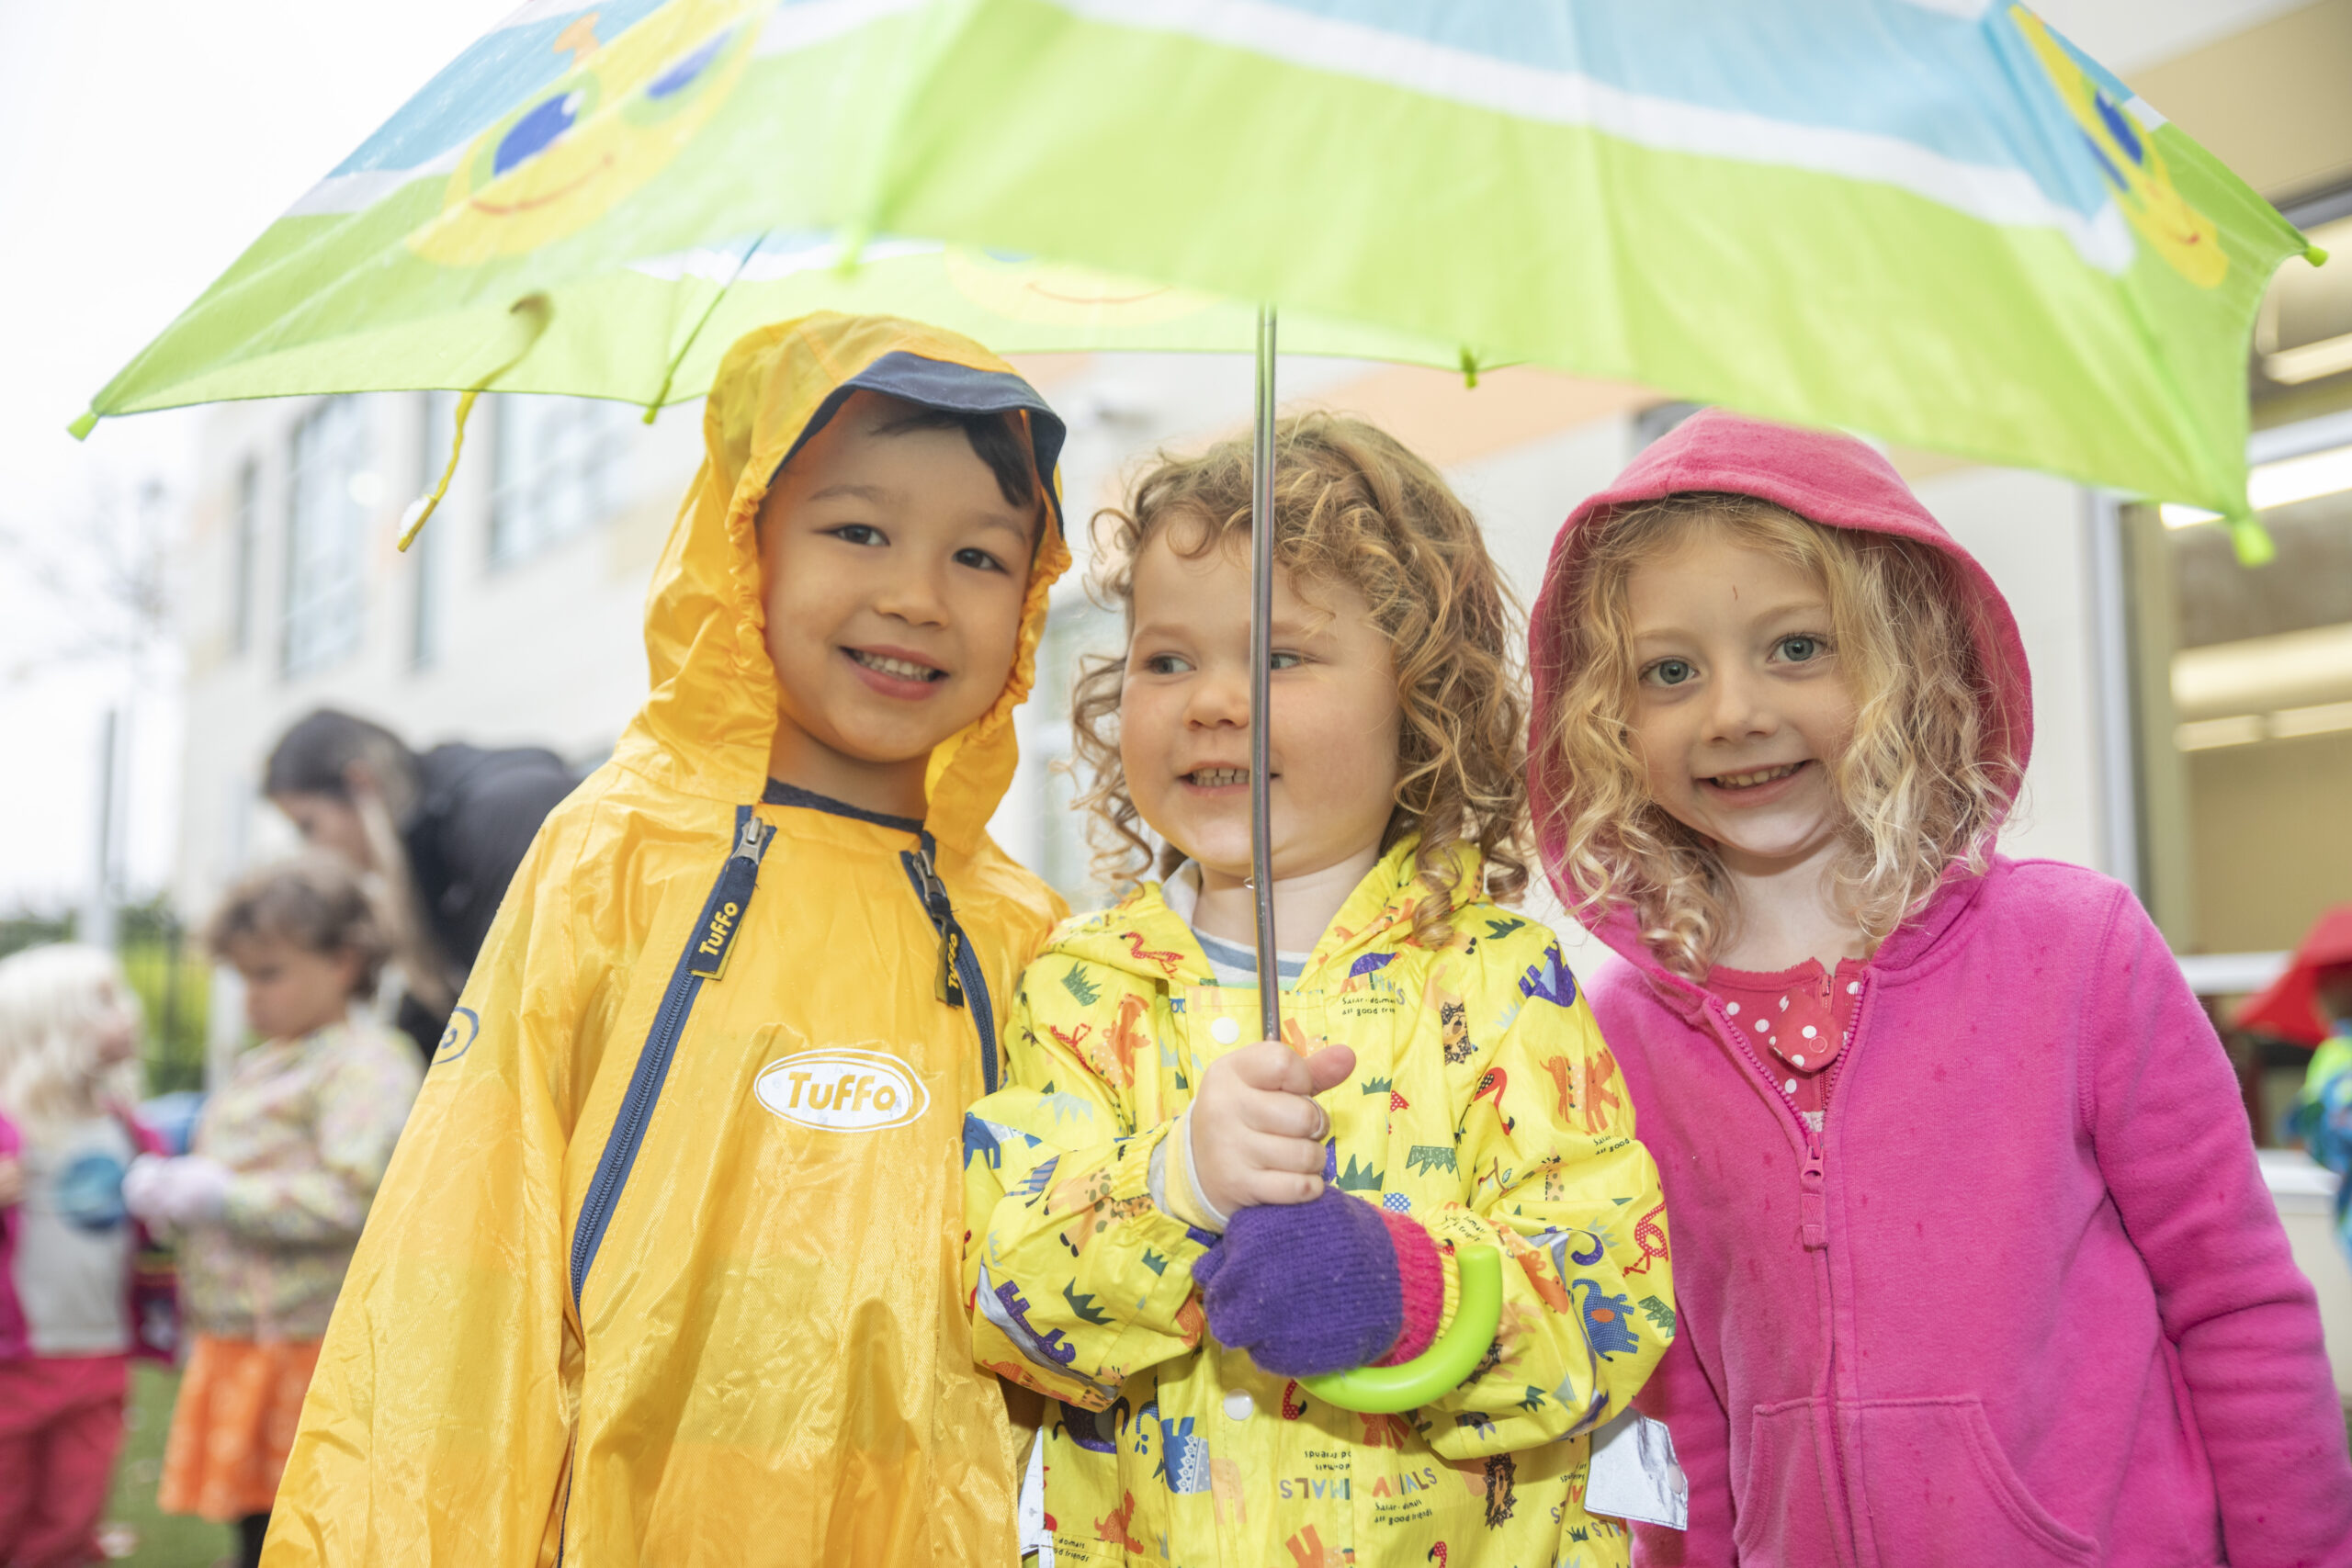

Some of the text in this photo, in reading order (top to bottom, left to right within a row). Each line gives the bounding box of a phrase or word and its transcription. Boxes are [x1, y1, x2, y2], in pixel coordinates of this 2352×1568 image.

[698, 901, 739, 955] Tuffo
[947, 932, 958, 989] Tuffo
[1356, 1007, 1378, 1017] good
[788, 1071, 897, 1111] Tuffo
[1388, 1514, 1410, 1526] good
